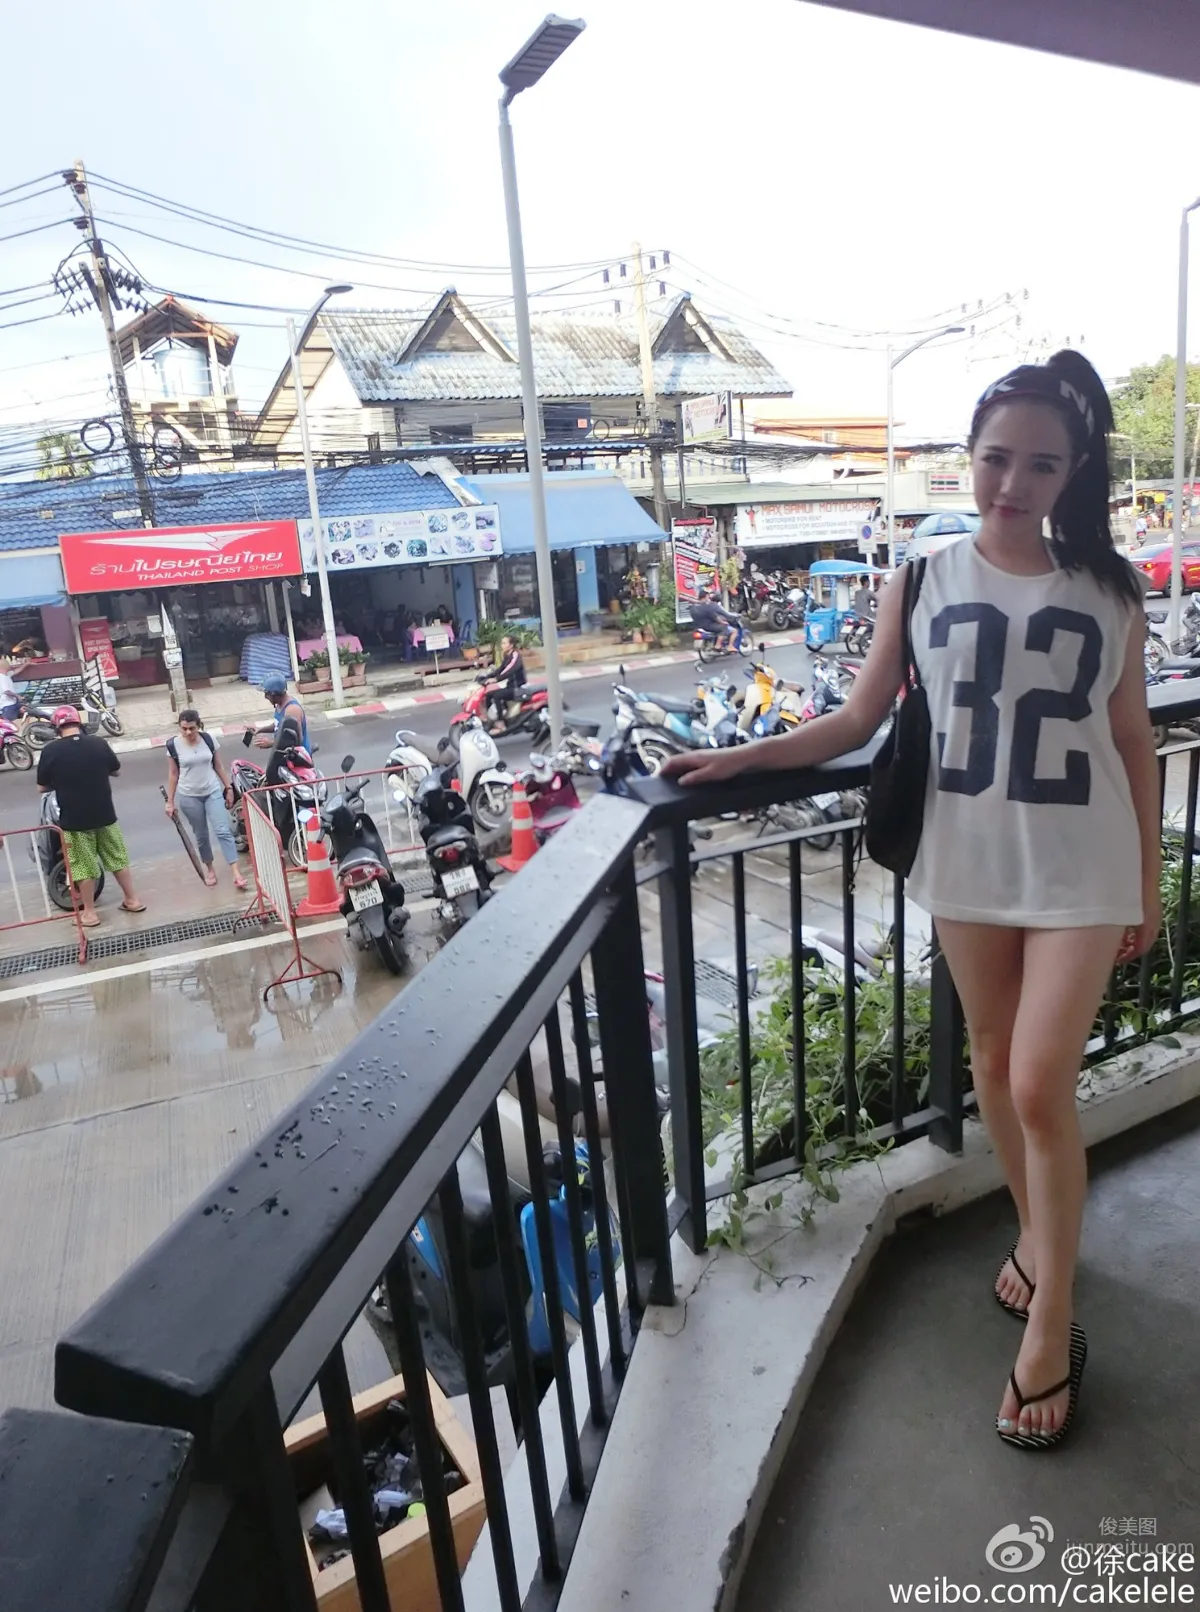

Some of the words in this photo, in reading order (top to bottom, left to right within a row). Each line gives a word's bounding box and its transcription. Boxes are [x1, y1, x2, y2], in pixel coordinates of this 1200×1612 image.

[761, 504, 783, 517] MAX
[784, 502, 814, 515] SAMUI
[765, 523, 798, 531] MOTOCROSS
[90, 550, 283, 577] ร้านไปรษณีย์ไทย
[138, 568, 205, 582] THAILAND
[209, 566, 243, 576] POST
[247, 562, 284, 573] SHOP
[929, 602, 1103, 806] 32
[359, 896, 378, 909] 670
